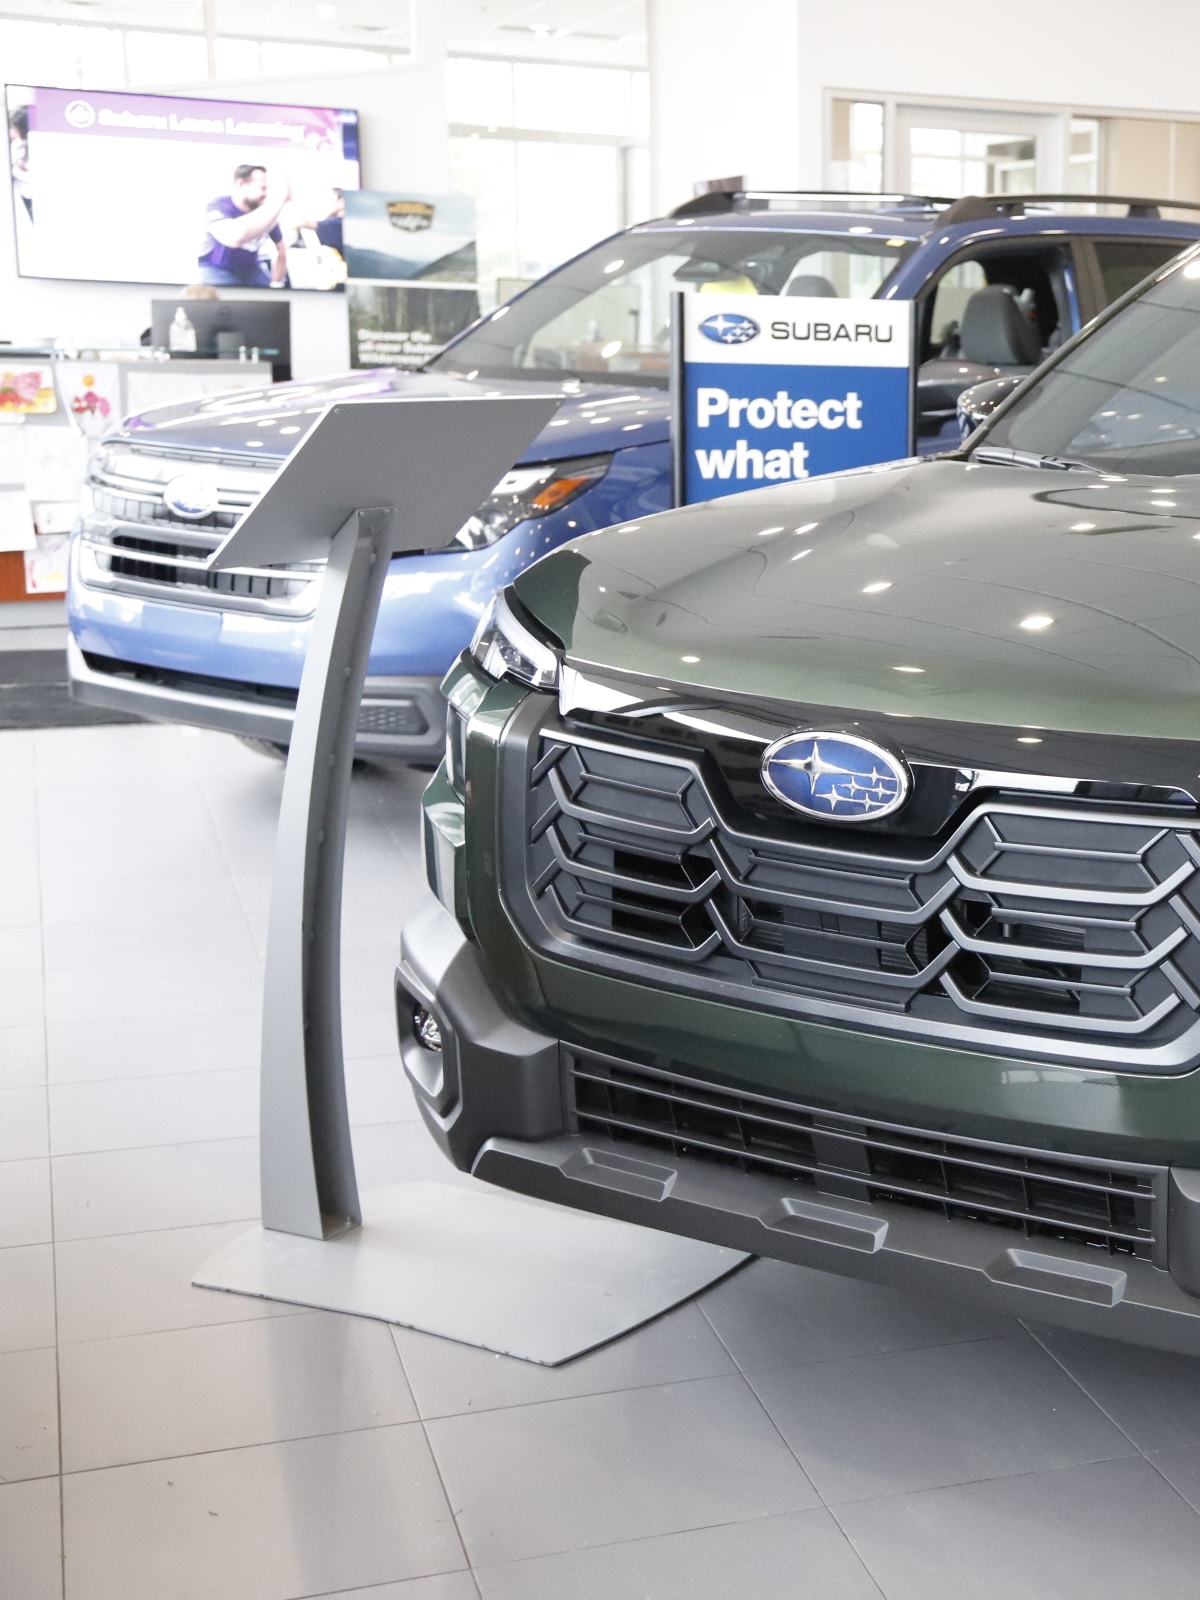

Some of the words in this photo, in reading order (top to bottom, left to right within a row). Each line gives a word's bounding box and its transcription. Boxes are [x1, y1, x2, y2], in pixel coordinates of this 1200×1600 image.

[98, 108, 168, 130] Subaru
[770, 321, 893, 342] SUBARU
[696, 387, 863, 430] Protect
[695, 440, 809, 479] what
